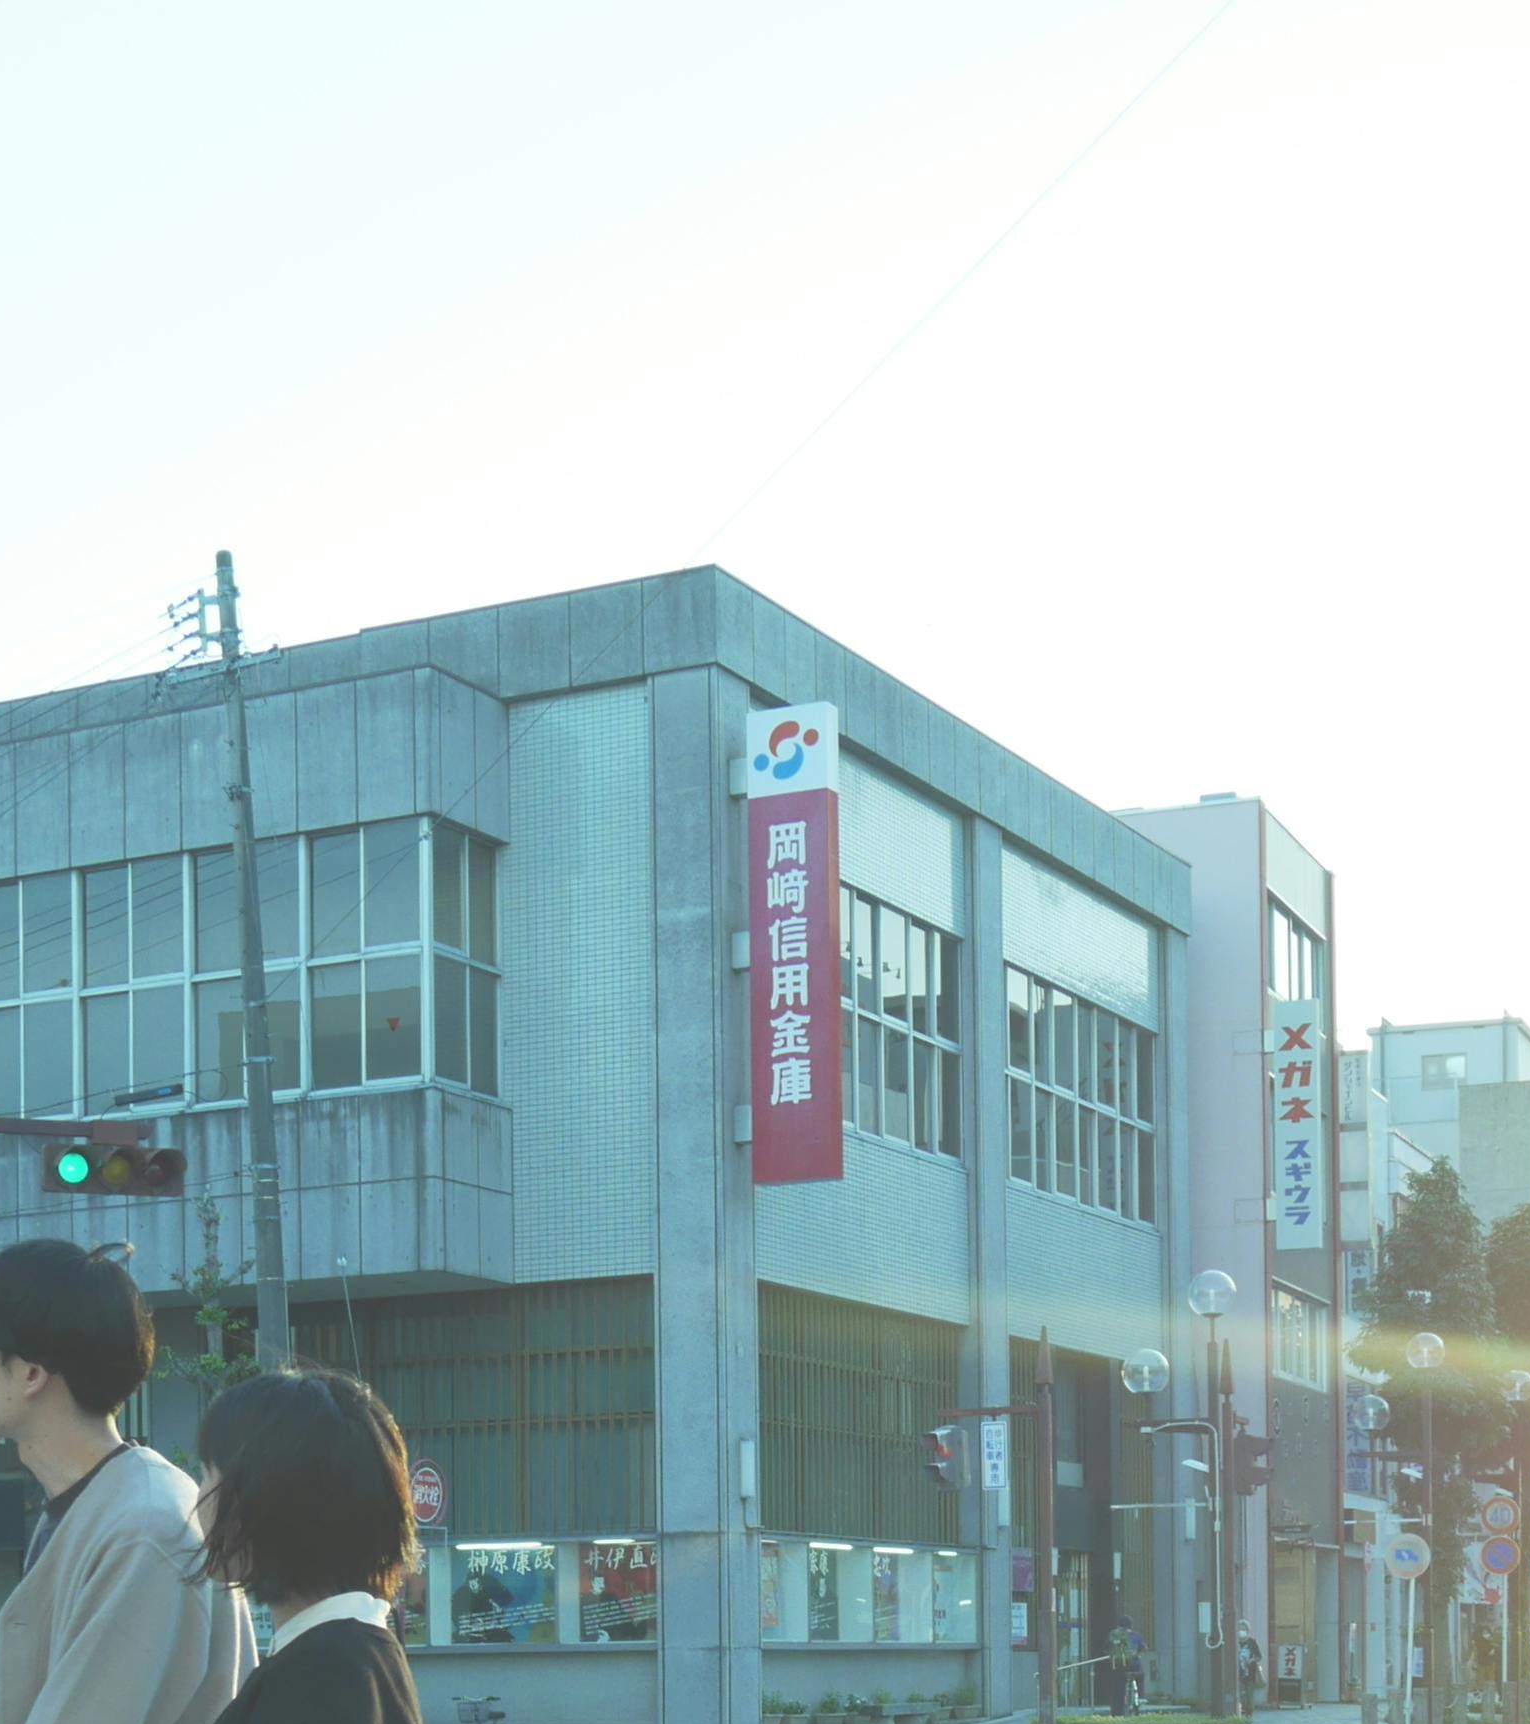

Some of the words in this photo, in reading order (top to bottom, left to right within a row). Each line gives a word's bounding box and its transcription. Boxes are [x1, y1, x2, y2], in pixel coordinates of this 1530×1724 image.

[1278, 1022, 1314, 1124] メガネ
[1284, 1139, 1312, 1226] スギウラ
